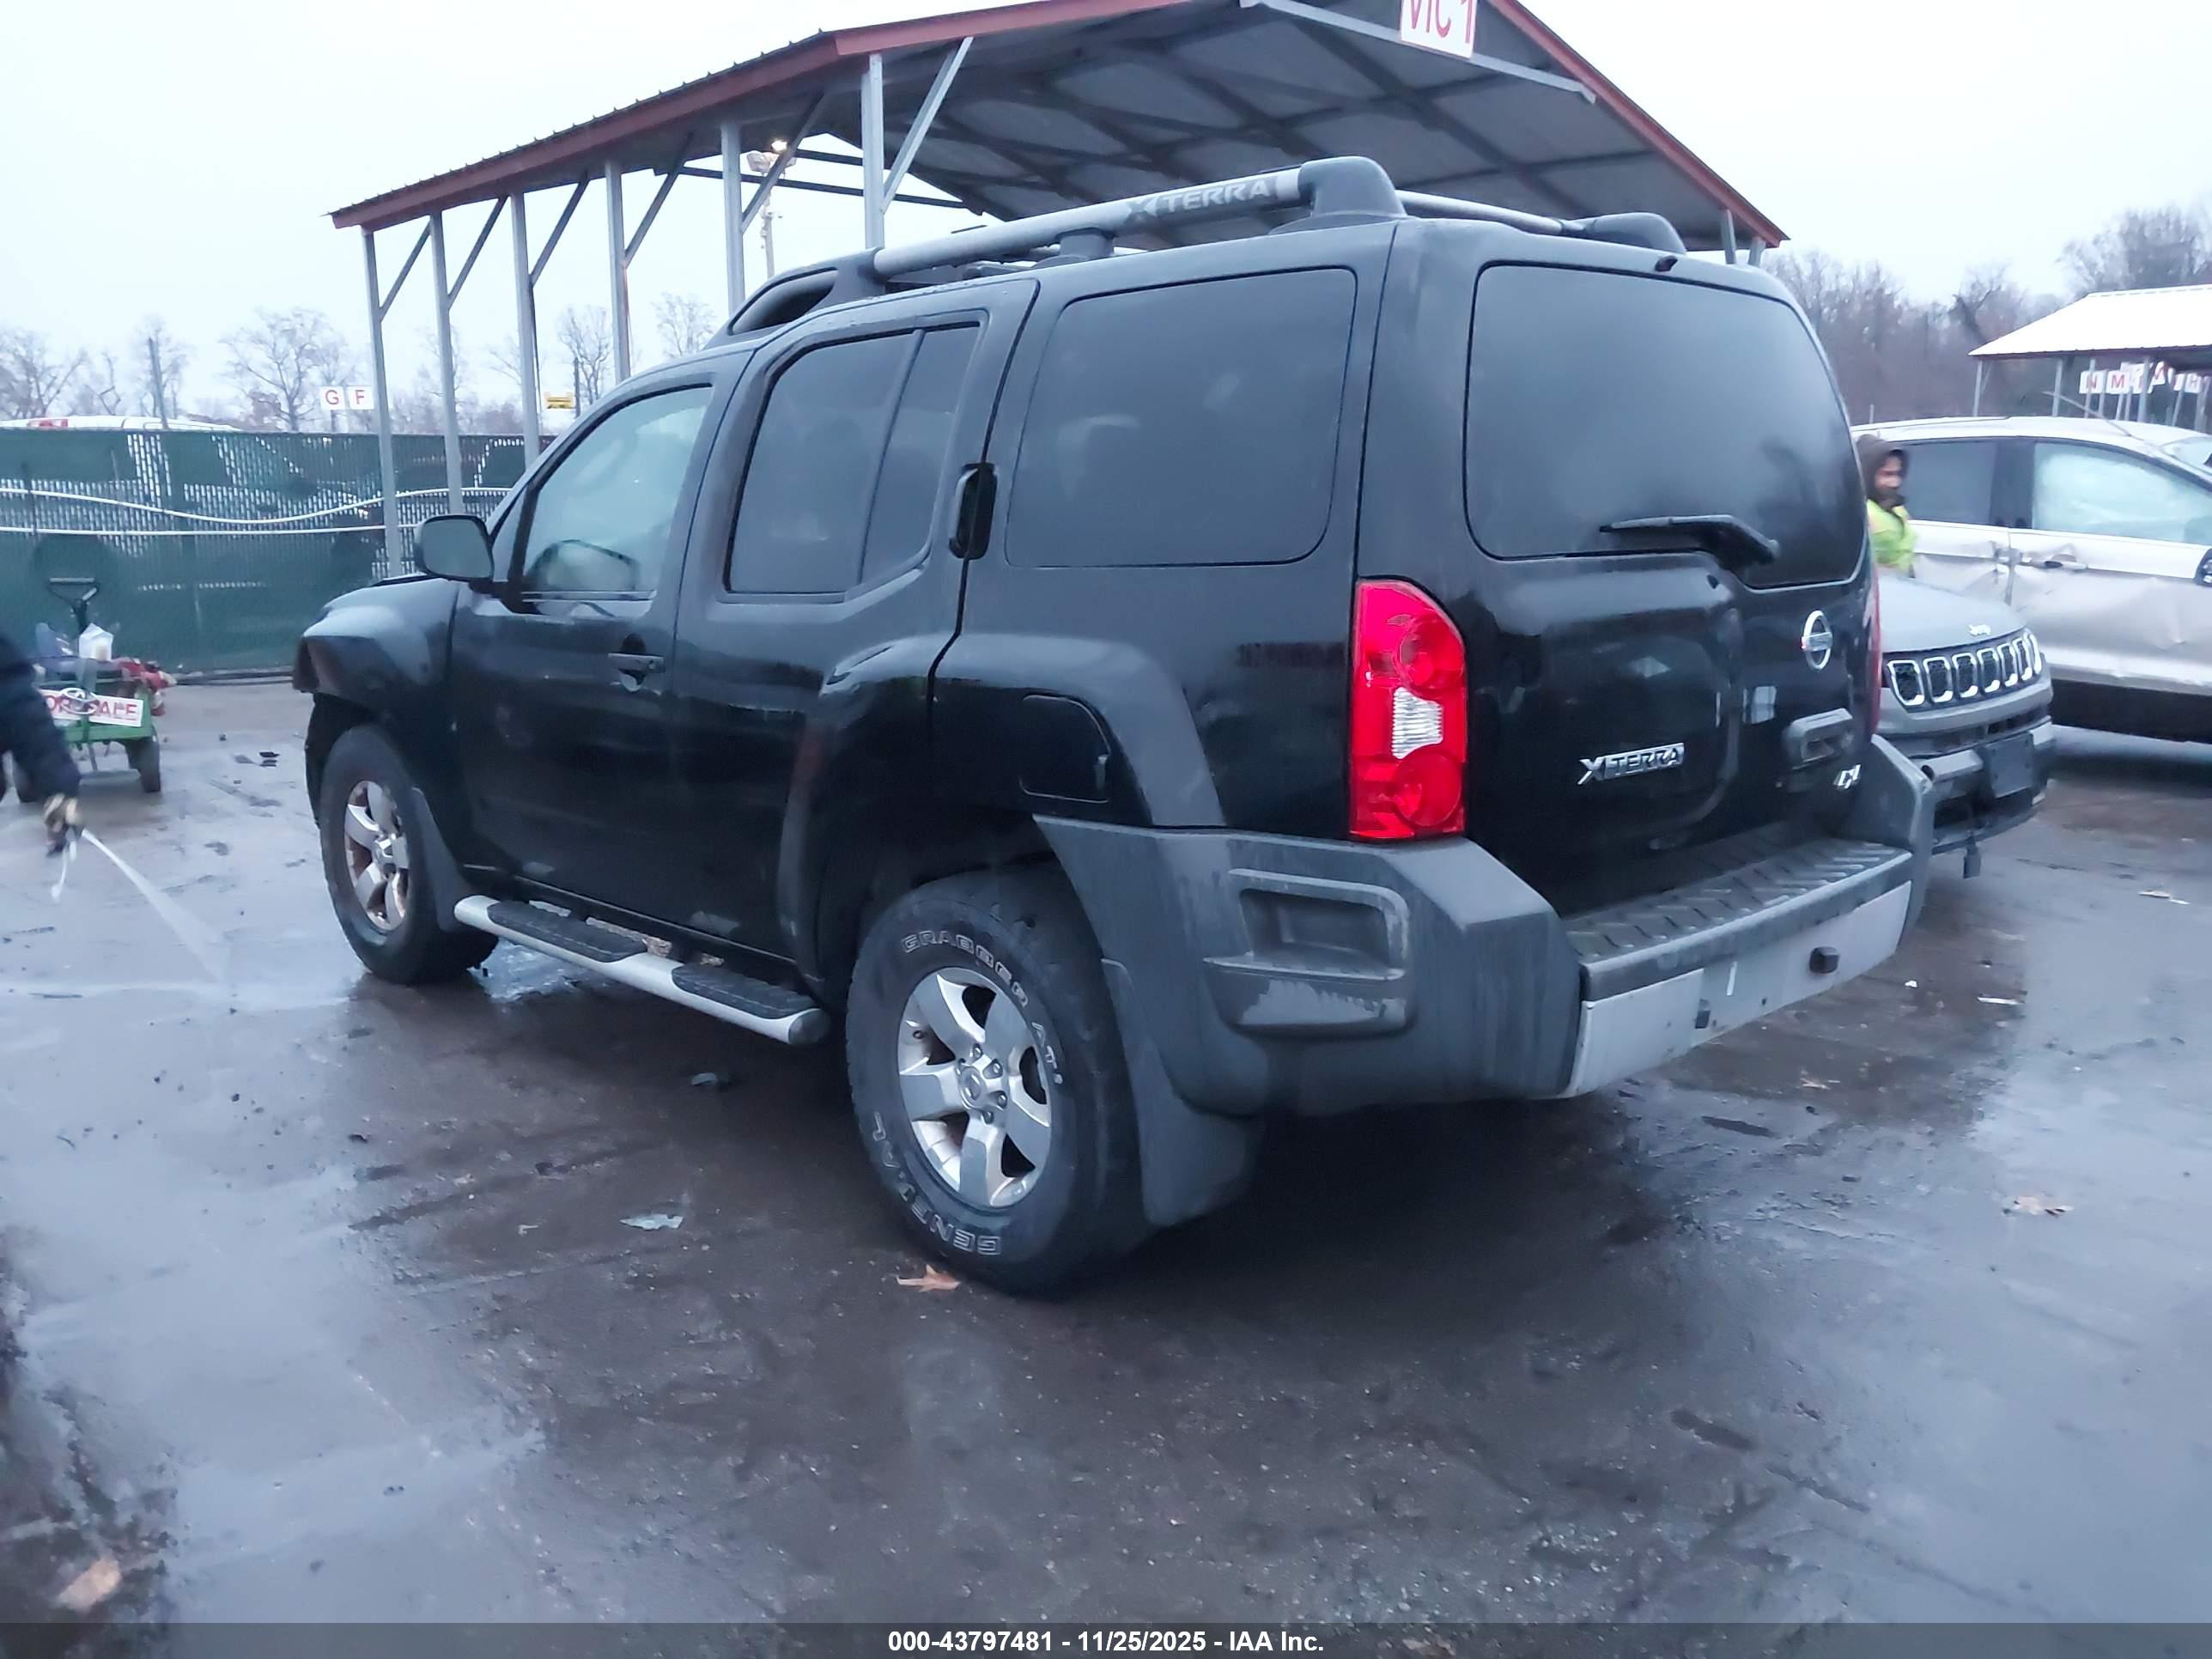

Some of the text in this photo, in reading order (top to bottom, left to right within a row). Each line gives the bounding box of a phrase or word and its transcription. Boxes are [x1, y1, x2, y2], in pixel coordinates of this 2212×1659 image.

[1409, 0, 1473, 44] VIC 1
[1128, 179, 1270, 217] XTERRA
[325, 389, 339, 404] G
[356, 389, 364, 404] F
[2111, 374, 2124, 389] M
[1577, 743, 1684, 785] XTERRA
[902, 930, 1029, 1007] GRABBER
